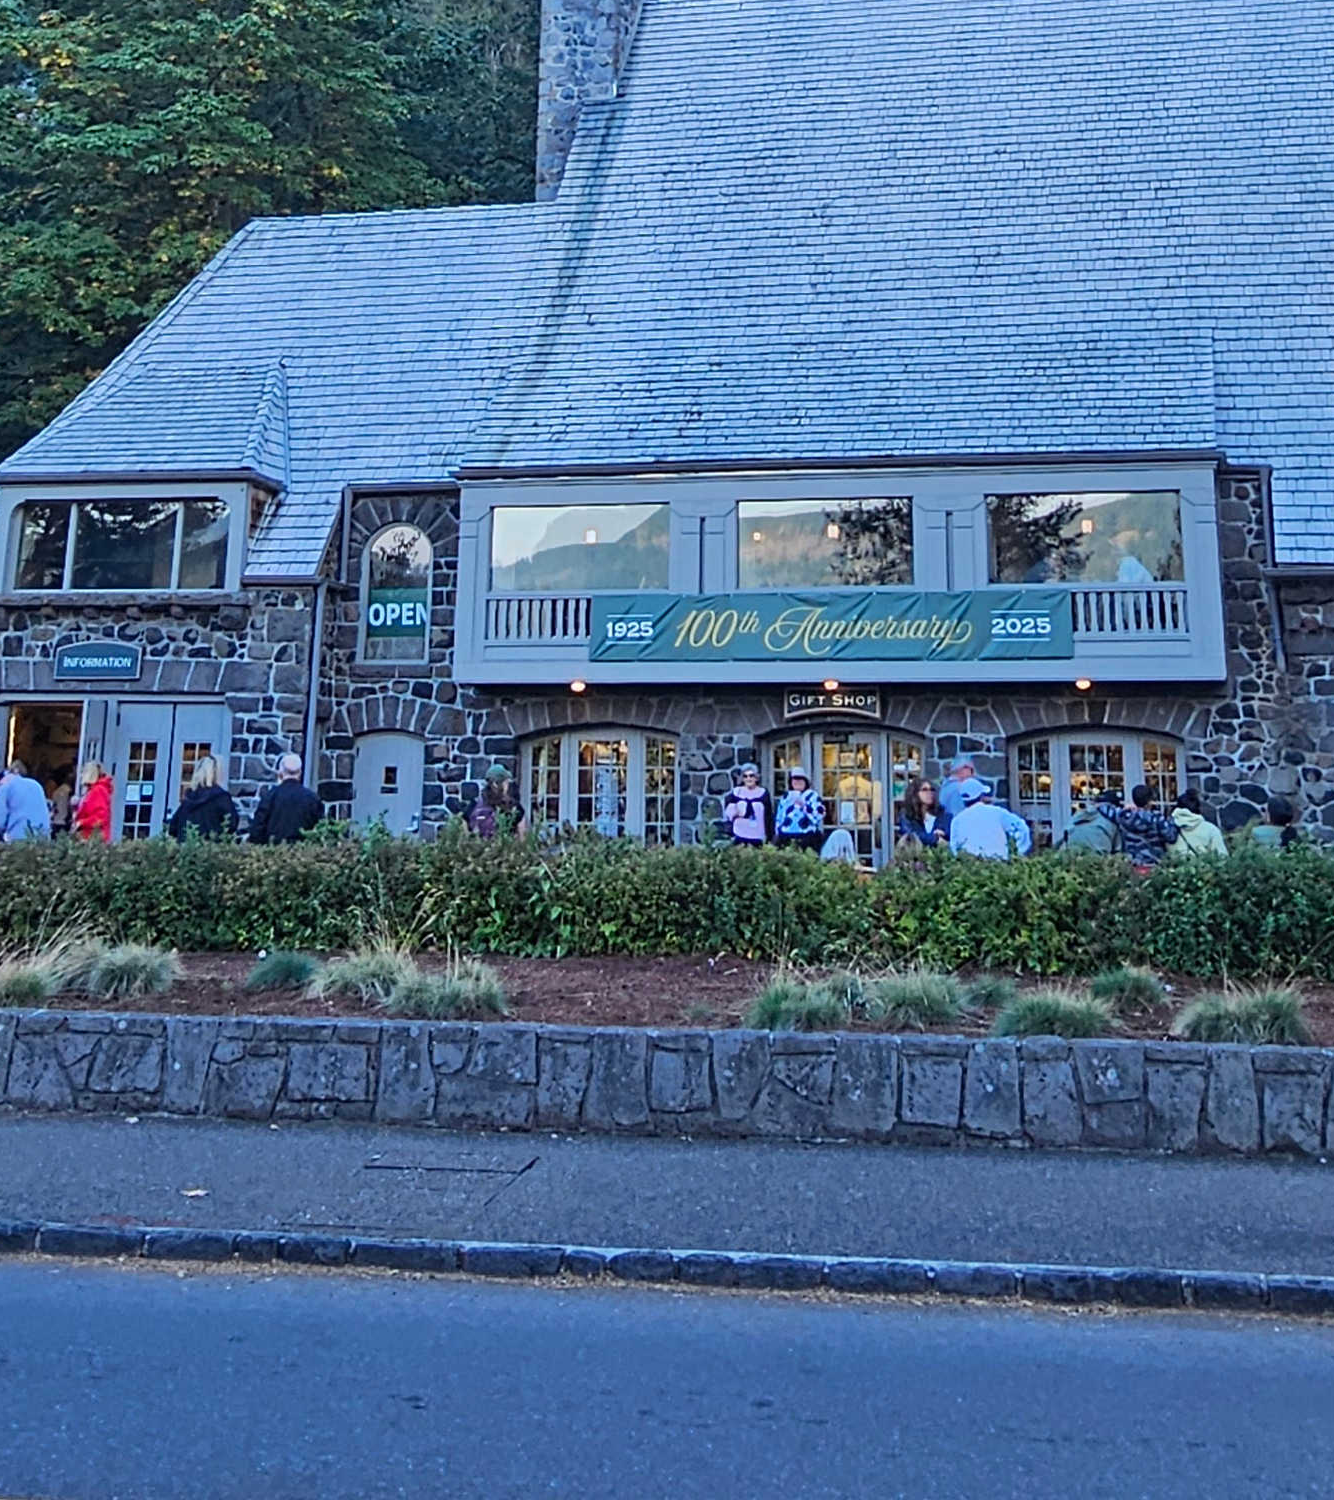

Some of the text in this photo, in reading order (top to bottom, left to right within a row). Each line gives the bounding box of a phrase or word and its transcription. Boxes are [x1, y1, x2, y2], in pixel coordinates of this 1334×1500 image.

[369, 602, 428, 626] OPEN
[606, 621, 654, 638] 1925
[674, 606, 972, 656] 100th Anniversary
[991, 617, 1052, 634] 2025
[63, 656, 132, 668] INFORMATION
[789, 694, 876, 706] GIFT SHOP
